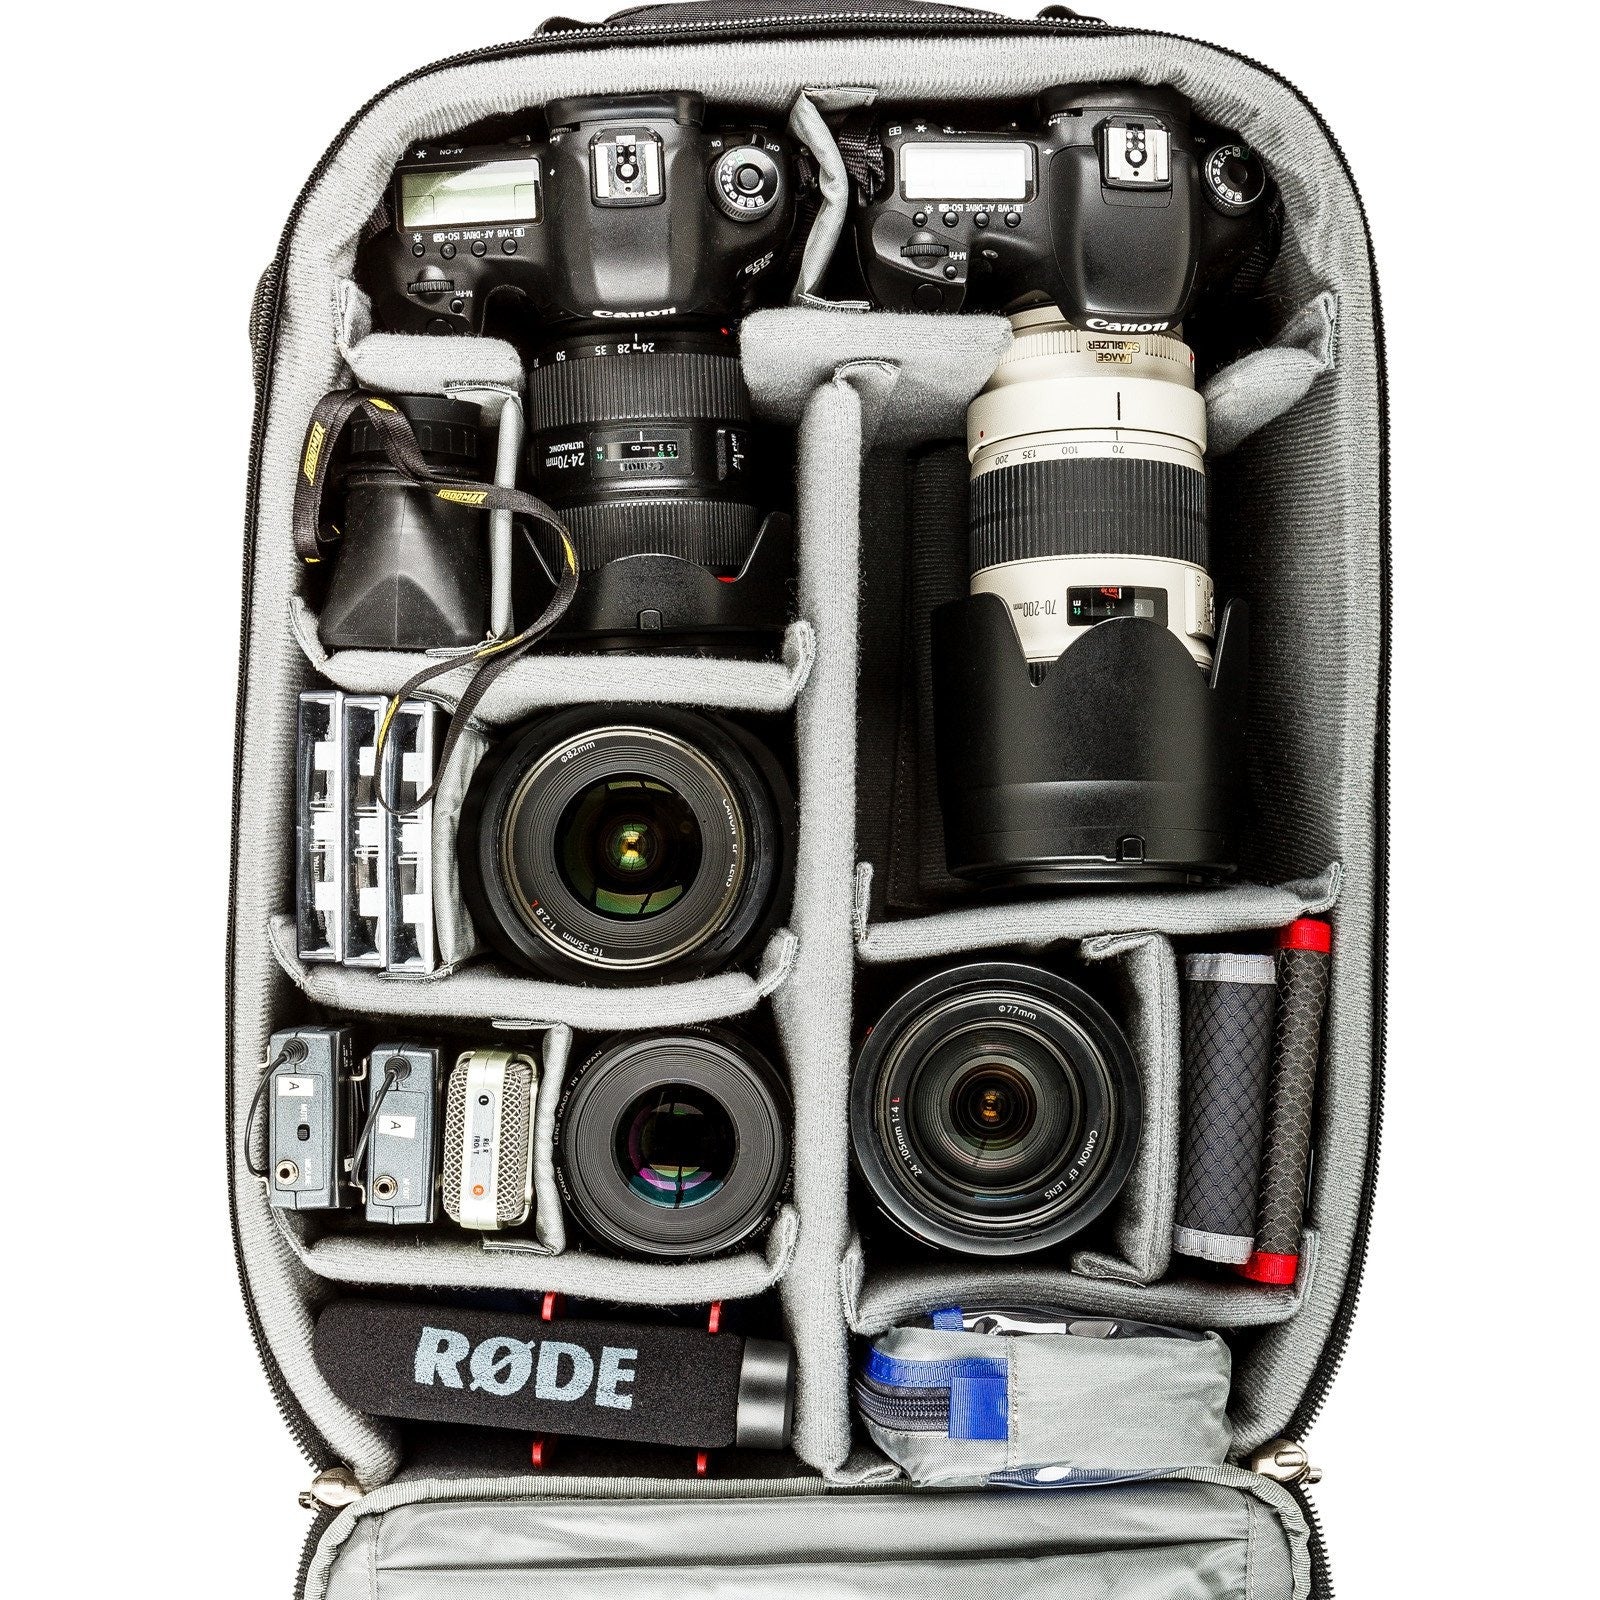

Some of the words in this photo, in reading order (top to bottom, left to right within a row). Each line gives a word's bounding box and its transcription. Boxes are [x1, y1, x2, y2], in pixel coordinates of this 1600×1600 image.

[711, 140, 722, 148] ON
[766, 142, 780, 152] OFF
[951, 204, 964, 212] ISO
[447, 231, 460, 241] ISO
[744, 251, 774, 274] EOS
[949, 251, 967, 261] M-Fn
[455, 289, 473, 298] M-Fn
[592, 306, 677, 319] Canon
[1085, 317, 1170, 332] Canon
[594, 345, 607, 355] 35
[617, 343, 630, 354] 28
[641, 343, 656, 352] 24
[1088, 340, 1140, 352] STABILIZER
[556, 350, 567, 361] 50
[1098, 352, 1131, 362] IMAGE
[549, 440, 585, 454] ULTRASONIC
[658, 443, 665, 451] 3
[666, 443, 677, 451] 1.5
[545, 452, 586, 469] 24-70mm
[995, 454, 1009, 465] 200
[1022, 448, 1037, 459] 135
[1061, 446, 1079, 455] 100
[1112, 445, 1125, 455] 70
[1013, 599, 1057, 618] 70-200mm
[530, 900, 539, 908] L
[535, 907, 557, 931] 1:2.8
[562, 931, 604, 957] 16-35mm
[579, 1050, 603, 1075] JAPAN
[288, 1081, 300, 1091] A
[570, 1076, 579, 1087] IN
[557, 1091, 571, 1118] MADE
[891, 1106, 900, 1123] 1:4
[390, 1120, 402, 1130] A
[1077, 1130, 1098, 1167] CANON
[1068, 1168, 1079, 1181] EF
[556, 1166, 571, 1201] CANON
[781, 1172, 793, 1195] LENS
[1044, 1180, 1067, 1200] LENS
[414, 1326, 639, 1411] RØDE
